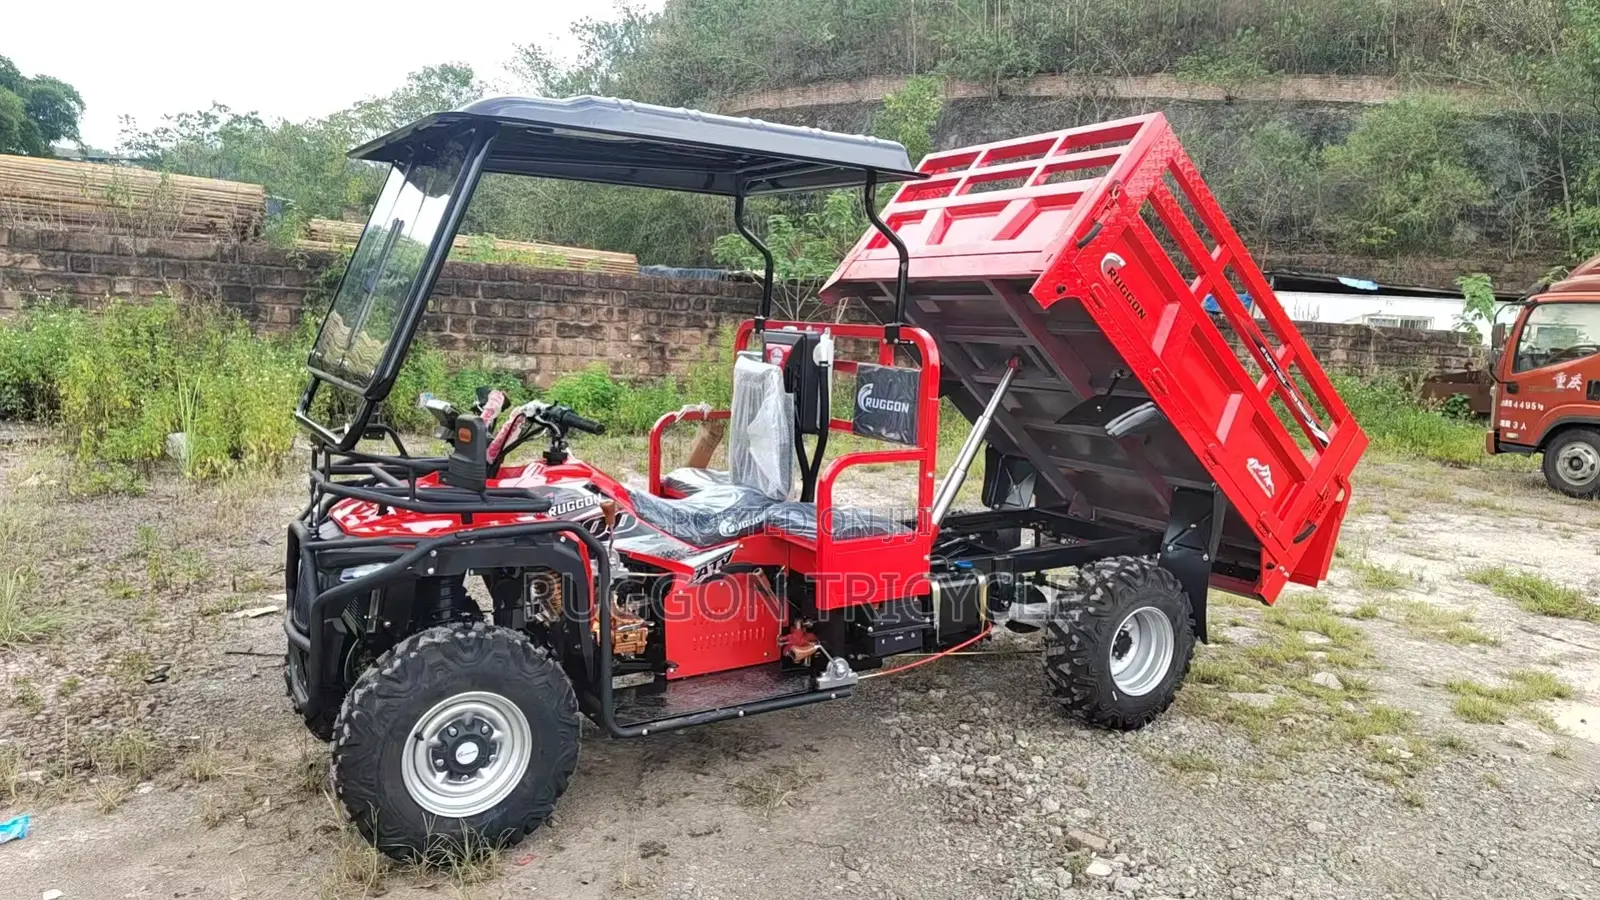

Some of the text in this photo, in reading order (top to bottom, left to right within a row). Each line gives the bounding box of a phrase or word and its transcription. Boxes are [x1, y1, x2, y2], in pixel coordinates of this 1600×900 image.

[1107, 266, 1147, 320] RUGGON
[1552, 371, 1582, 391] 重庆
[864, 397, 910, 413] RUGGON
[548, 493, 602, 517] RUGGON
